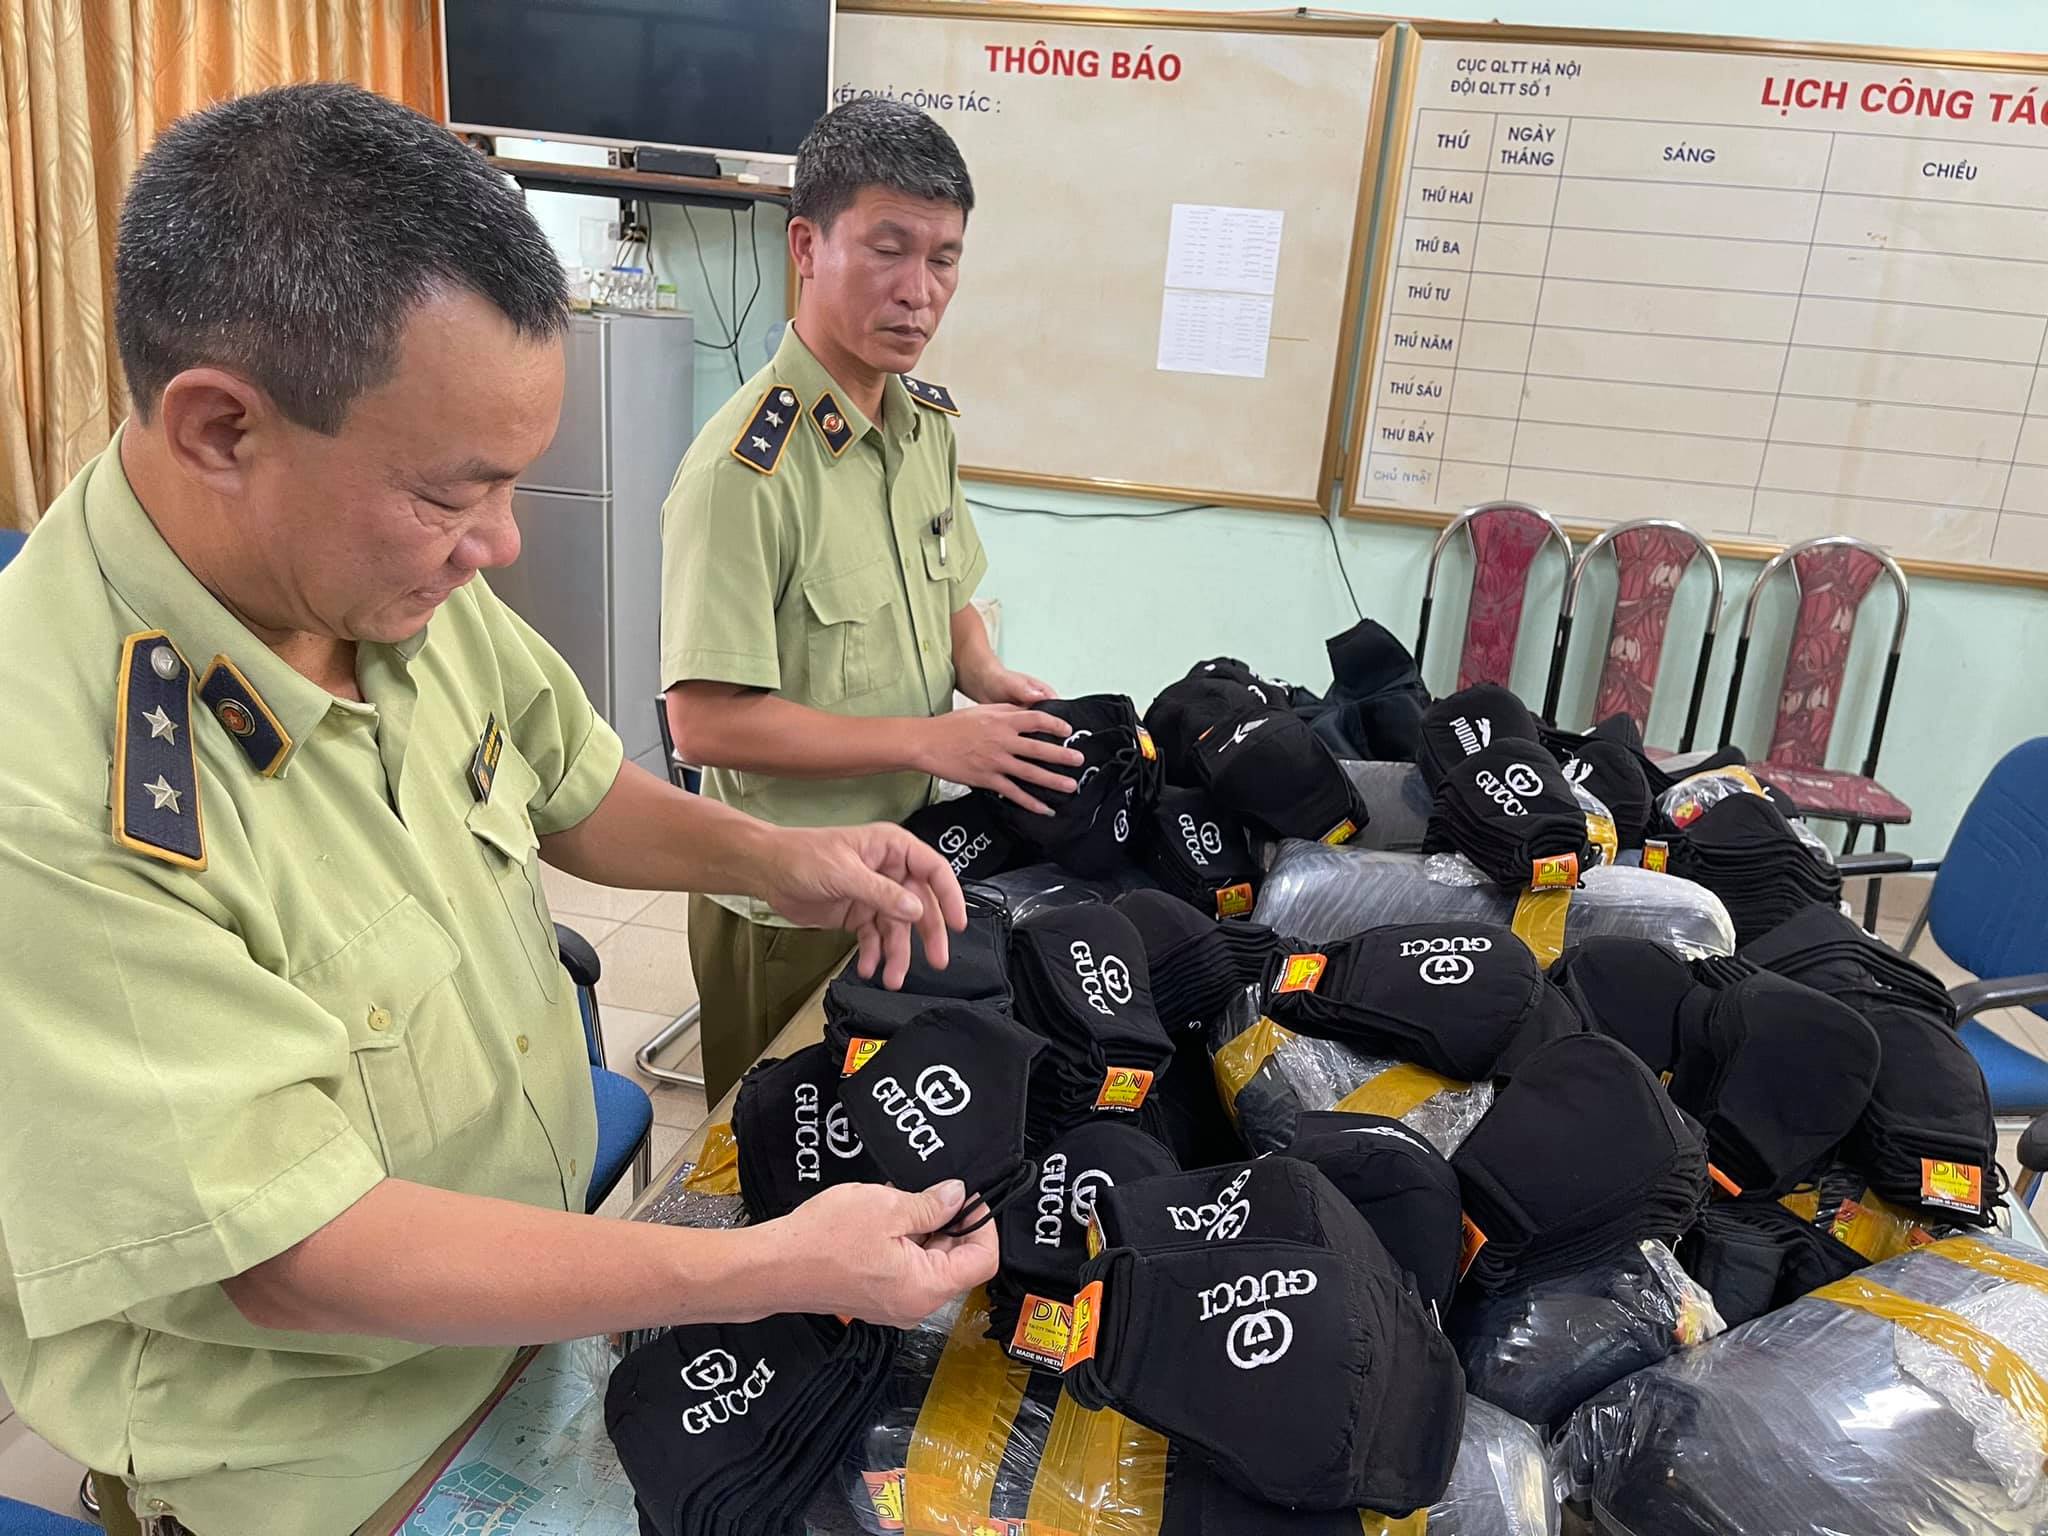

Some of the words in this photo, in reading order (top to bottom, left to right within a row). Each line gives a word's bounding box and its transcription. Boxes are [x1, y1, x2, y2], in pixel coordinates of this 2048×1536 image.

[984, 40, 1099, 78] THÔNG
[1111, 45, 1182, 81] BÁO
[1457, 58, 1487, 75] CỤC
[1490, 60, 1528, 74] QLTT
[1531, 58, 1551, 76] HÀ
[1555, 60, 1581, 79] NỘI
[1451, 77, 1476, 96] ĐỘI
[1479, 82, 1515, 95] QLTT
[1519, 78, 1541, 97] SỐ
[1544, 85, 1551, 96] 1
[901, 89, 953, 110] CÔNG
[958, 90, 990, 112] TÁC
[1761, 77, 1850, 116] LỊCH
[1860, 78, 1974, 120] CÔNG
[1437, 129, 1471, 149] THỨ
[1508, 124, 1556, 143] NGÀY
[1501, 146, 1555, 166] THÁNG
[1663, 141, 1716, 163] SÁNG
[1422, 185, 1447, 203] THỨ
[1449, 190, 1473, 204] HAI
[1415, 236, 1439, 253] THỨ
[1442, 241, 1460, 255] BA
[1408, 282, 1433, 300] THỨ
[1394, 330, 1418, 348] THỨ
[1420, 334, 1453, 351] NĂM
[1390, 375, 1415, 396] THỨ
[1416, 380, 1443, 398] SÁU
[1382, 419, 1406, 441] THỨ
[1449, 716, 1482, 756] PUMA
[1178, 814, 1209, 866] GUCCI
[1541, 859, 1570, 874] DN
[1400, 936, 1492, 957] GUCCI
[1112, 1071, 1145, 1088] DN
[872, 1076, 945, 1162] GUCCI
[794, 1083, 820, 1182] GUCCI
[1933, 1160, 1970, 1181] DN
[1034, 1153, 1068, 1249] GUCCI
[1166, 1168, 1252, 1232] GUCCI
[1198, 1269, 1318, 1321] GUCCI
[1033, 1300, 1073, 1329] DN
[1016, 1348, 1036, 1360] MADE
[1036, 1354, 1044, 1362] IN
[682, 1358, 776, 1434] GUCCI
